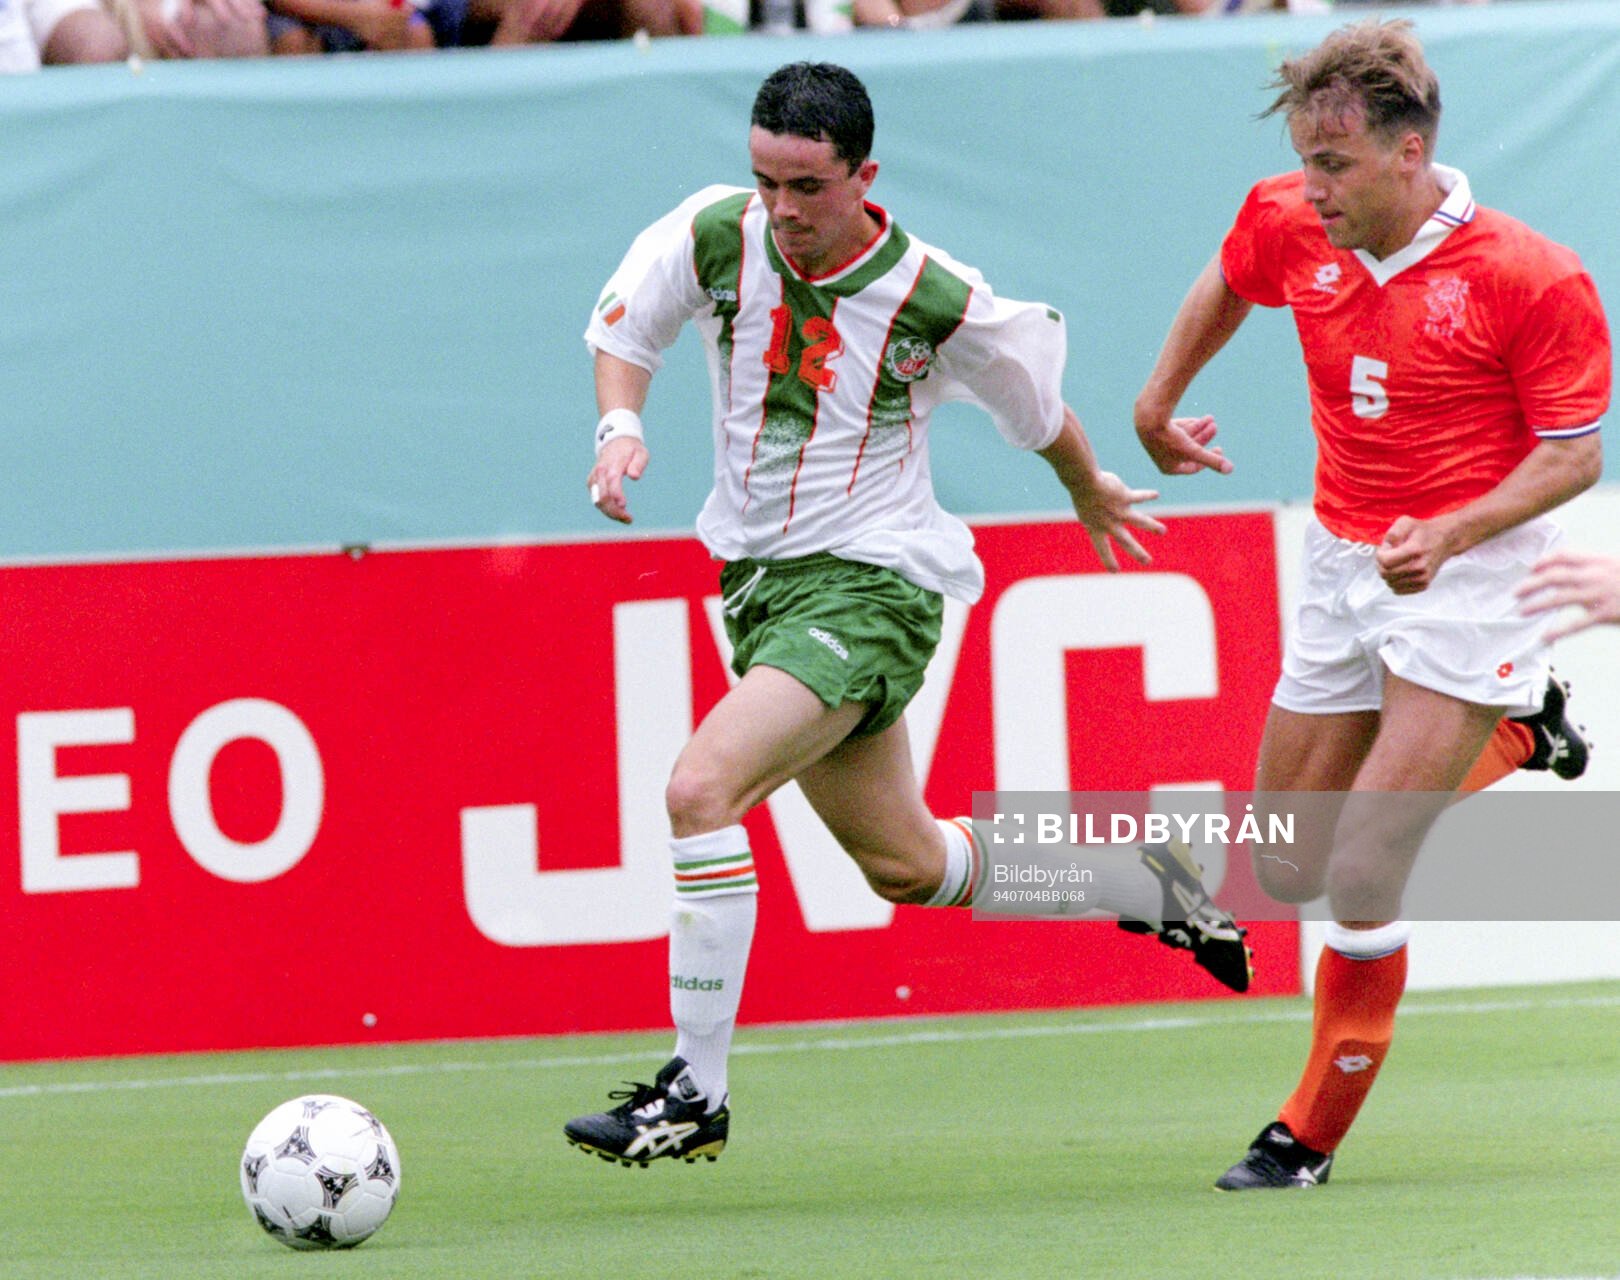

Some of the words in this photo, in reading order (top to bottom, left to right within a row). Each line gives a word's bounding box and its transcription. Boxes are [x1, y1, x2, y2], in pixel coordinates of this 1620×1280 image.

[763, 303, 846, 393] 12
[1350, 354, 1389, 419] 5
[808, 627, 848, 660] adidas
[16, 697, 325, 894] EO
[671, 975, 724, 991] didas
